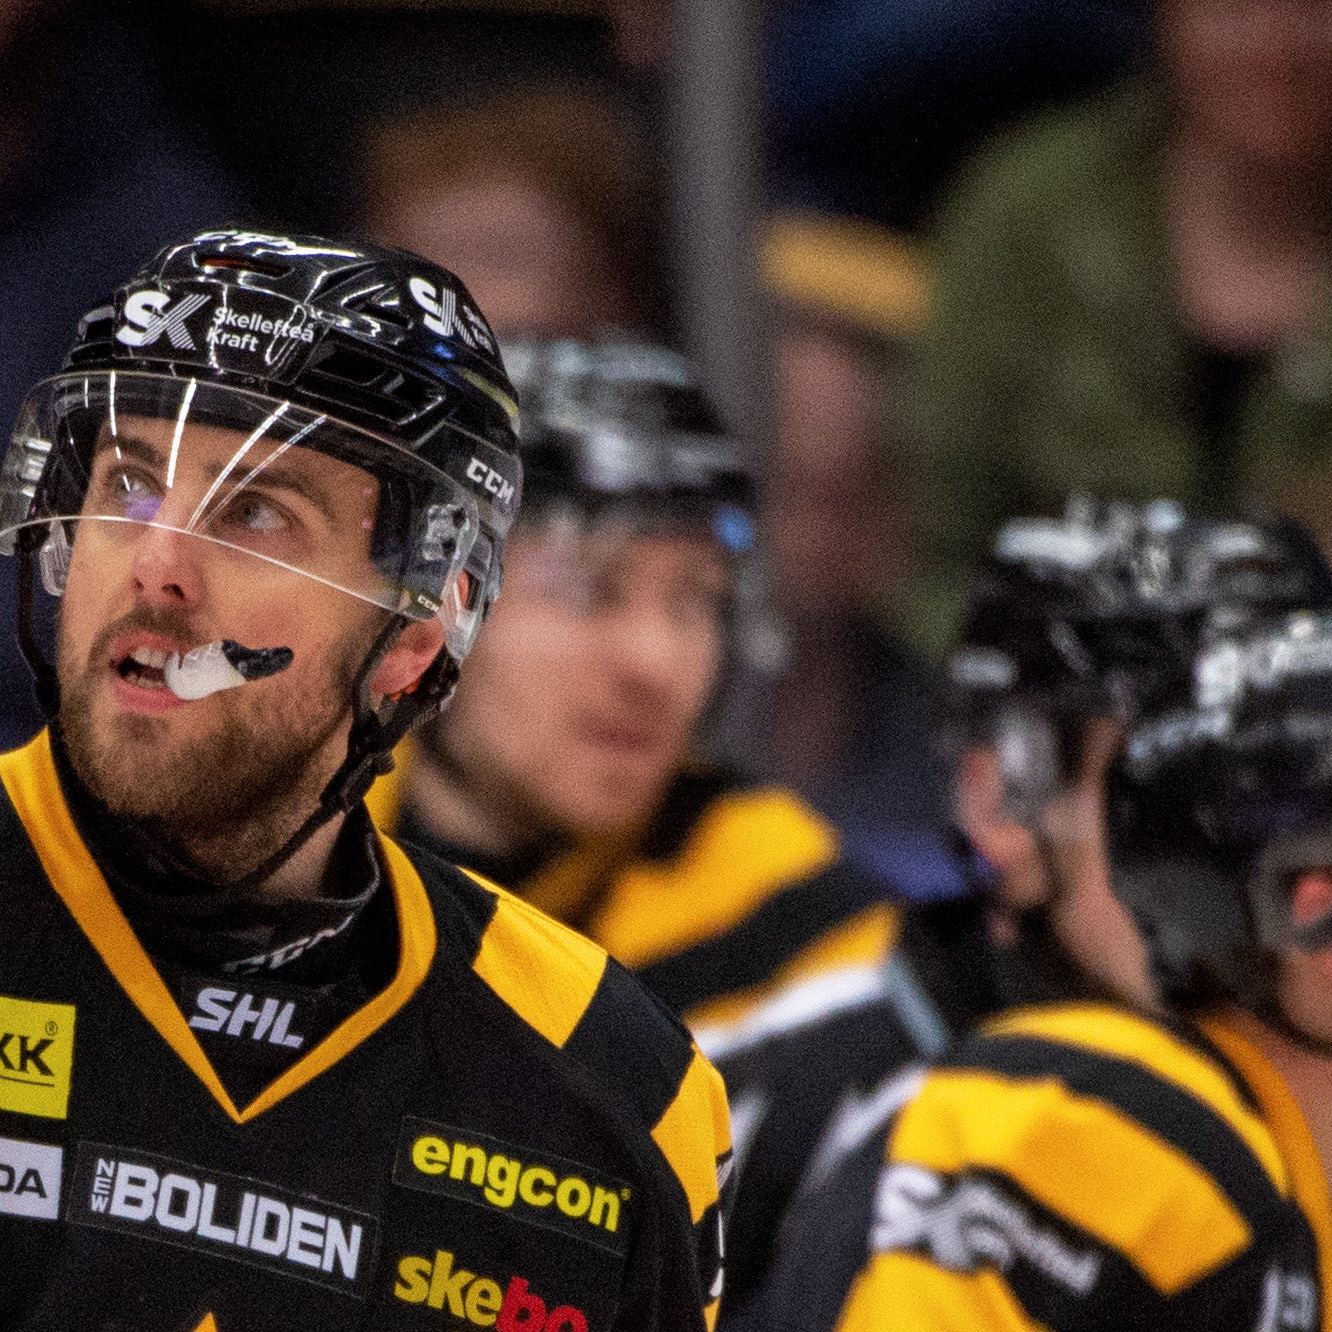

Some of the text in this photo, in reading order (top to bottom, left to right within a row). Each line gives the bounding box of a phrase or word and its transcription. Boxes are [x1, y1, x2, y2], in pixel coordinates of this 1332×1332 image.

[206, 327, 259, 352] Kraft
[212, 306, 315, 343] Skellefteå
[466, 447, 515, 505] CCM
[188, 986, 304, 1050] SHL
[411, 1134, 620, 1233] engcon
[90, 1157, 363, 1281] NEW BOLIDEN
